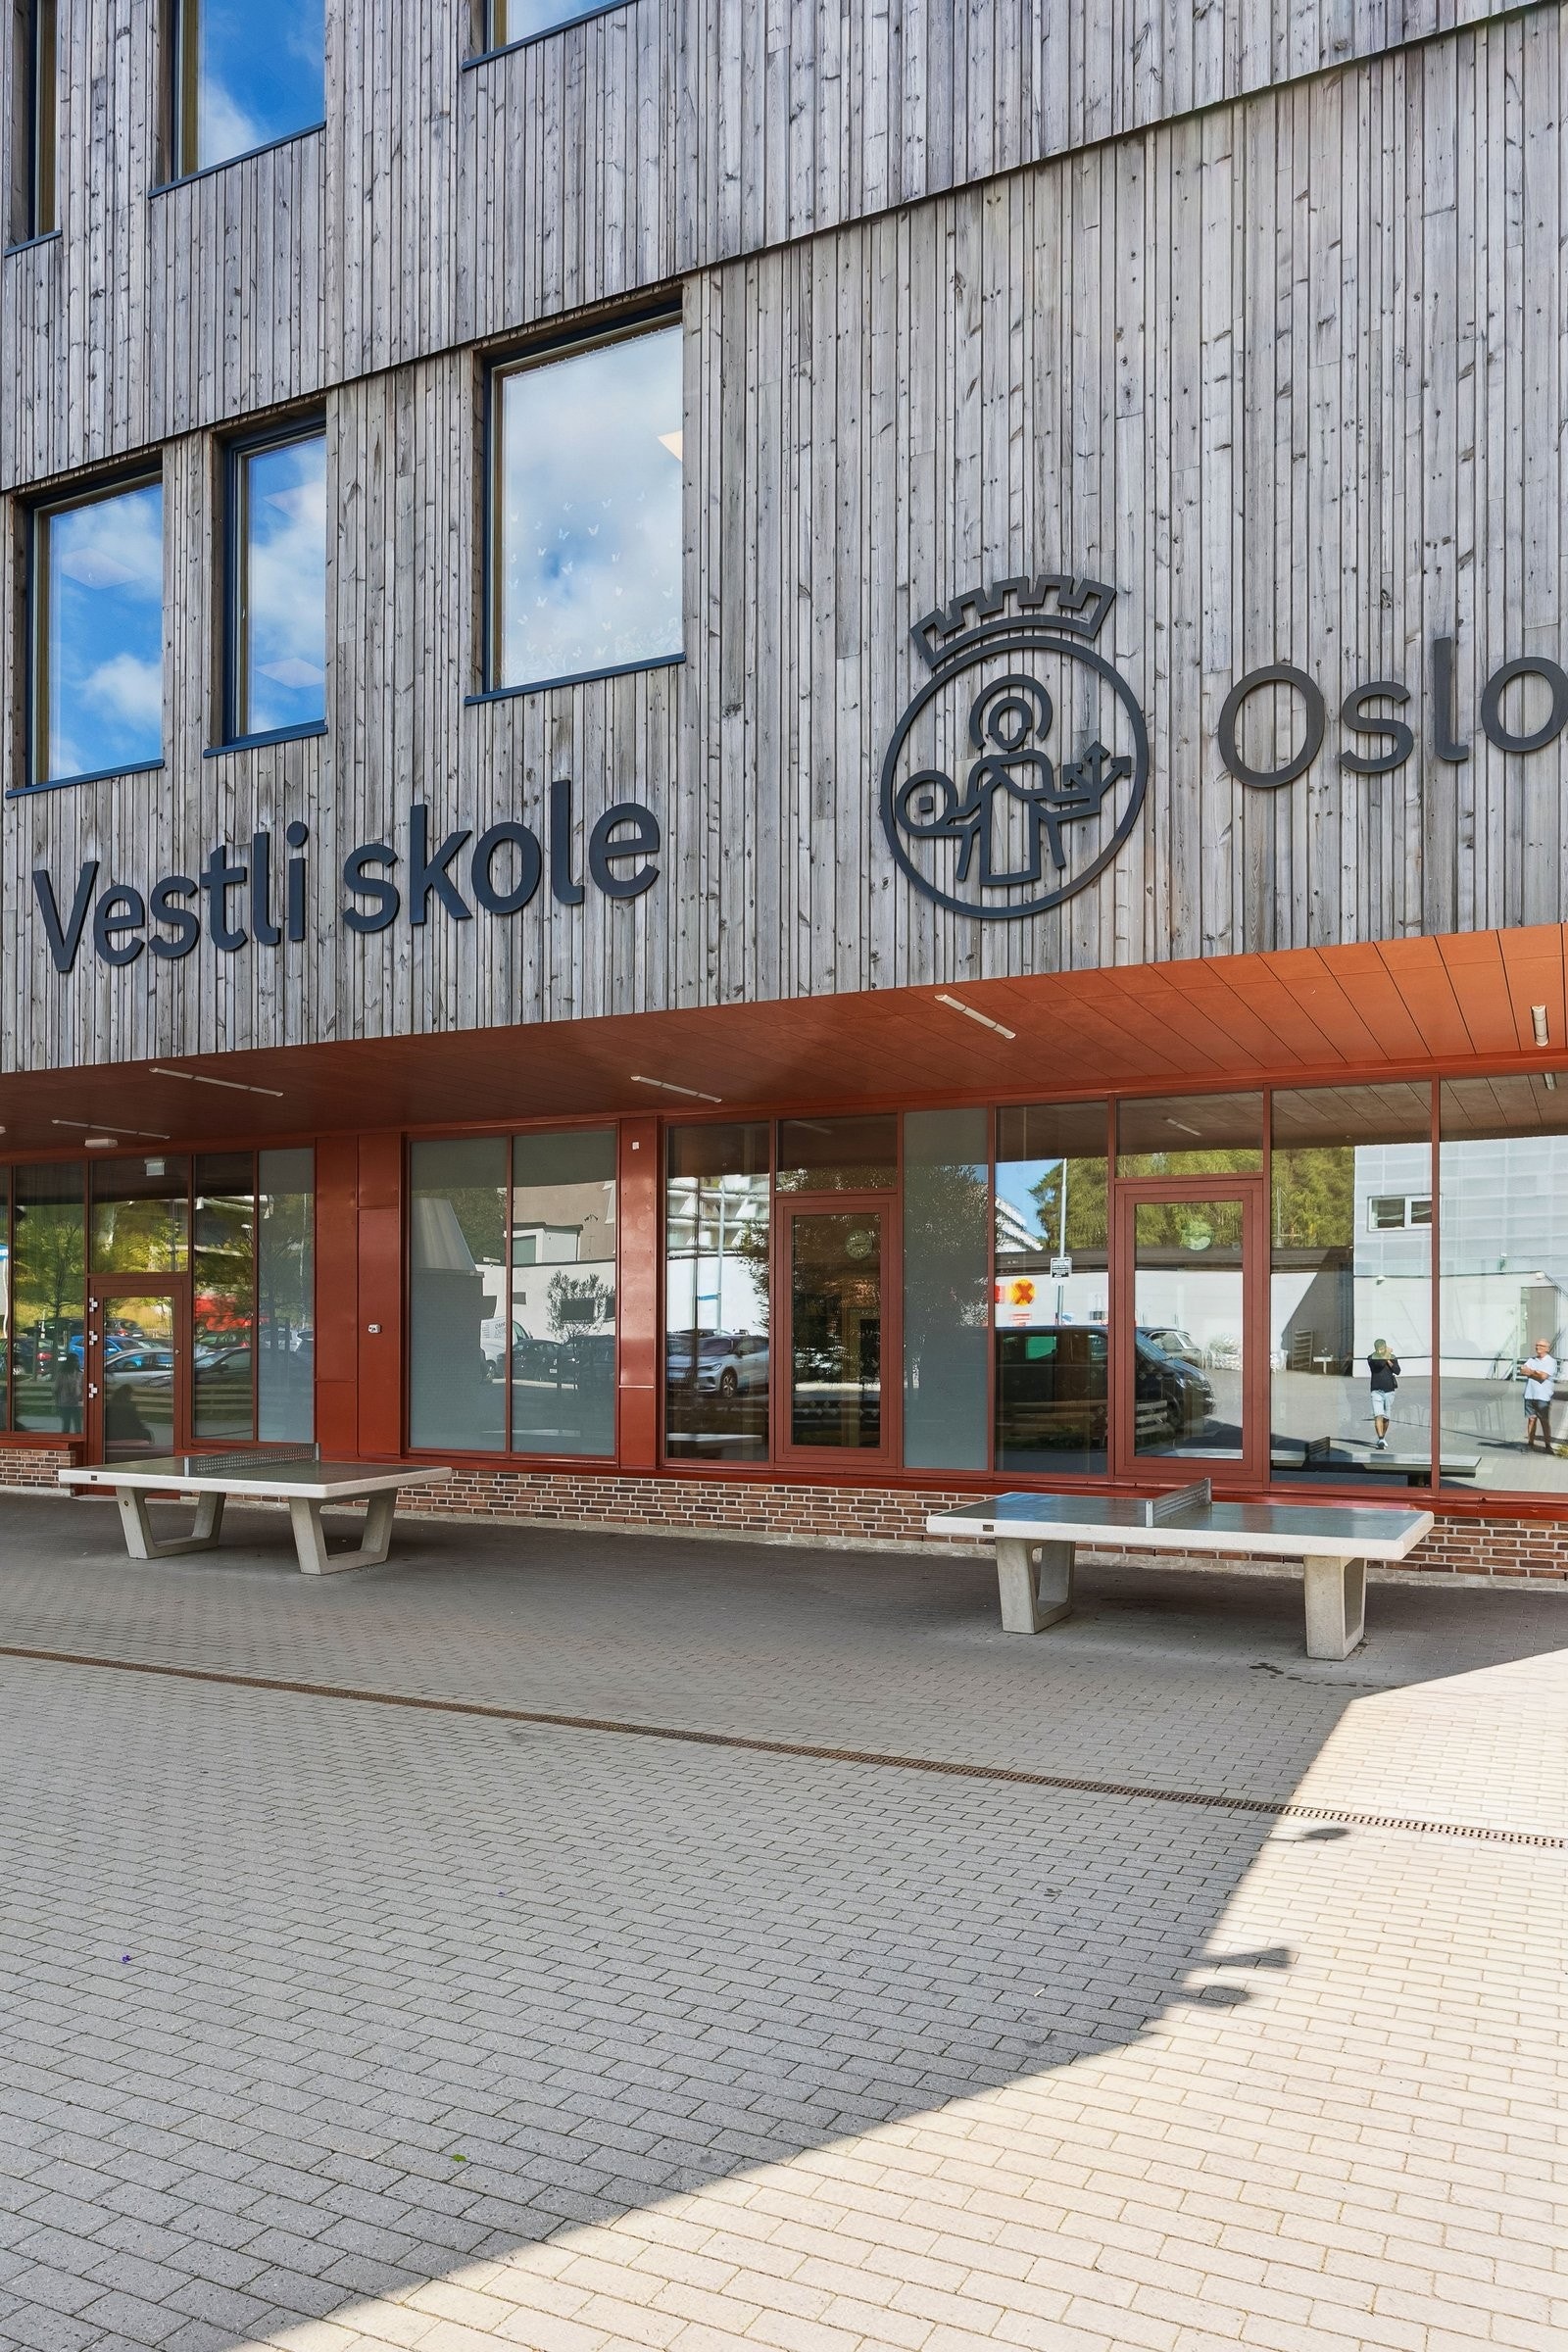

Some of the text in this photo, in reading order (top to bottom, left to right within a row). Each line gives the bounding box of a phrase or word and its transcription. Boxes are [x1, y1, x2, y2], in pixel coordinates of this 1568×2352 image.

[1218, 638, 1568, 788] Oslo
[33, 780, 661, 972] Vestli skole
